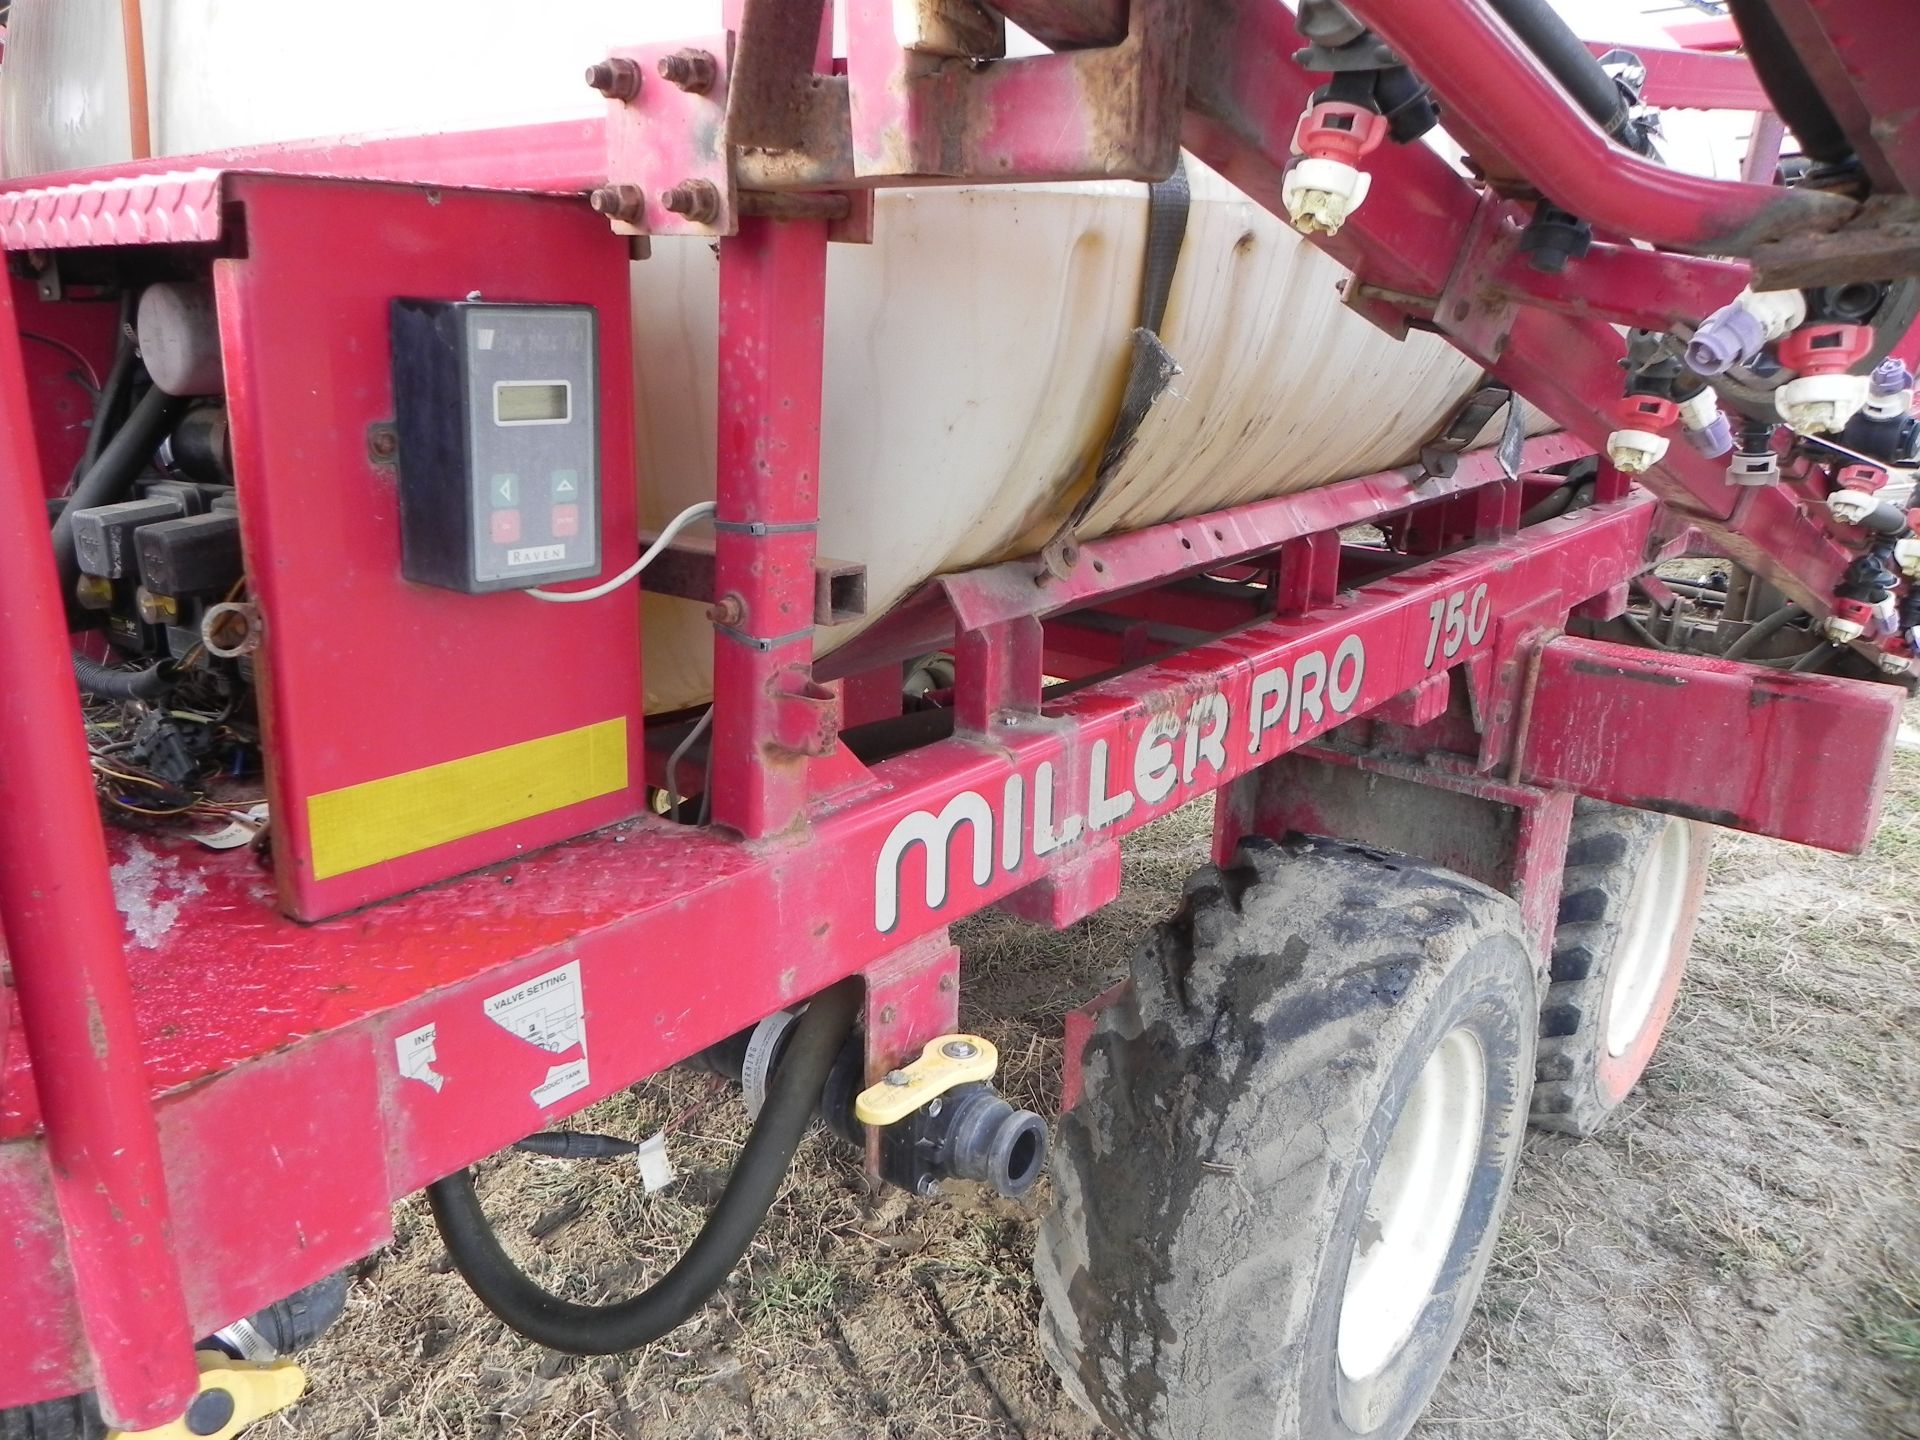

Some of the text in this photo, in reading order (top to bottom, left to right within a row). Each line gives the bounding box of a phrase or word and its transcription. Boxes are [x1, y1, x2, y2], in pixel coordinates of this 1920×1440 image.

[874, 690, 1229, 934] MILLER
[1248, 633, 1366, 754] PRO
[494, 972, 567, 1009] VALVE SETTING
[534, 1077, 564, 1095] PRODUCT
